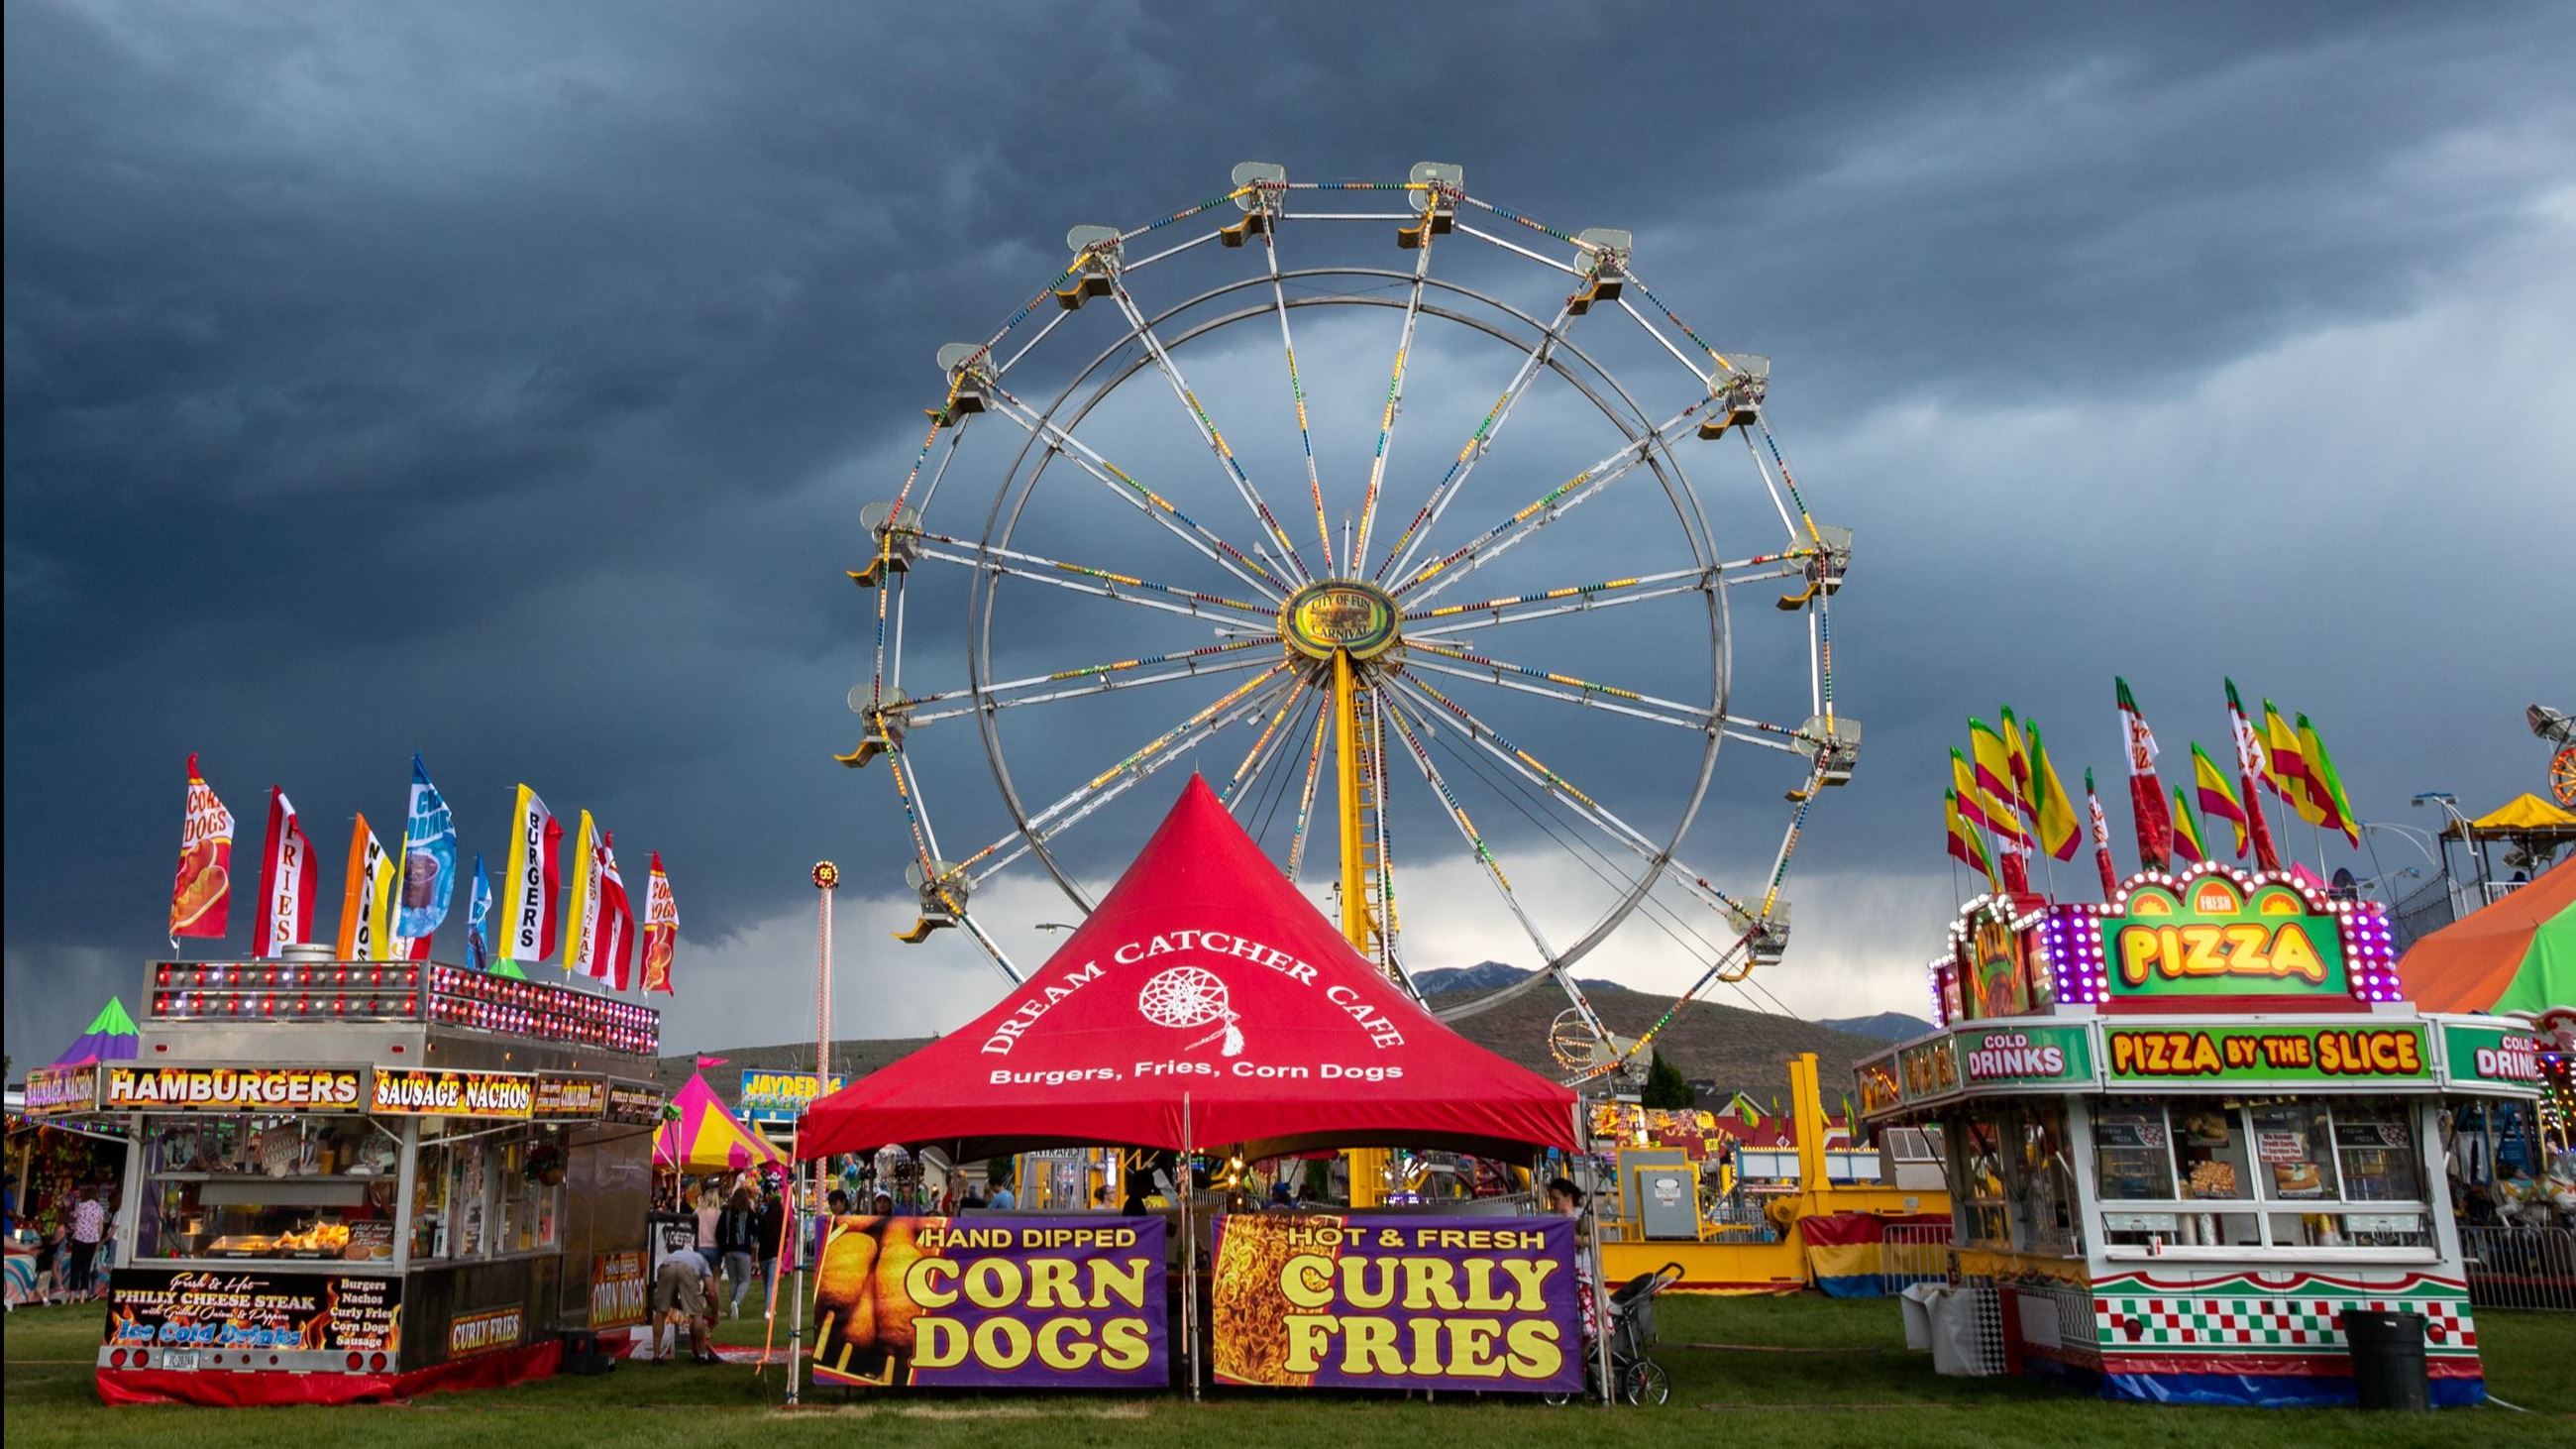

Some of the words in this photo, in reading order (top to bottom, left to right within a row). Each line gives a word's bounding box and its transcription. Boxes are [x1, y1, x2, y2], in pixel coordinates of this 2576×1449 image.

[1311, 595, 1333, 611] CITY
[1336, 595, 1348, 606] OF
[1350, 596, 1371, 612] FUN
[1311, 623, 1367, 639] CARNIVAL
[184, 810, 227, 843] DOGS
[276, 824, 299, 942] FRIES
[521, 811, 540, 947] BURGERS
[2200, 895, 2232, 912] FRESH
[2119, 923, 2328, 985] PIZZA
[981, 960, 1106, 1057] DREAM
[1114, 929, 1319, 987] CATCHER
[1326, 984, 1406, 1051] CAFE
[1984, 1034, 2028, 1049] COLD
[2111, 1032, 2222, 1075] PIZZA
[2225, 1037, 2259, 1067] BY
[2262, 1036, 2311, 1067] THE
[2316, 1031, 2420, 1074] SLICE
[990, 1066, 1124, 1086] Burgers,
[1134, 1059, 1222, 1079] Fries,
[1231, 1061, 1310, 1079] Corn
[1320, 1063, 1404, 1081] Dogs
[1967, 1045, 2066, 1079] DRINKS
[26, 1081, 61, 1107] SAUSAGE
[110, 1070, 357, 1103] HAMBURGERS
[377, 1078, 460, 1107] SAUSAGE
[465, 1081, 530, 1110] NACHOS
[746, 1074, 843, 1099] JAYDEBG
[264, 1136, 294, 1155] GOOD
[921, 1229, 1013, 1248] HAND
[1022, 1229, 1137, 1248] DIPPED
[1288, 1227, 1366, 1247] HOT
[1378, 1229, 1405, 1247] &
[1418, 1230, 1545, 1250] FRESH
[208, 1278, 221, 1289] &
[224, 1276, 269, 1293] Hot
[341, 1278, 386, 1291] Burgers
[905, 1257, 1151, 1309] CORN
[1279, 1255, 1558, 1312] CURLY
[114, 1289, 175, 1305] PHILLY
[180, 1291, 251, 1308] CHEESE
[255, 1295, 315, 1310] STEAK
[342, 1292, 383, 1304] Nachos
[593, 1282, 618, 1324] CORN
[619, 1278, 644, 1319] DOGS
[330, 1306, 363, 1320] Curly
[365, 1307, 392, 1319] Fries
[118, 1319, 155, 1341] Ice
[159, 1321, 216, 1343] Cold
[217, 1323, 303, 1347] Drinks
[331, 1321, 360, 1332] Corn
[363, 1322, 390, 1335] Dogs
[336, 1335, 382, 1348] Sausage
[453, 1319, 489, 1352] CURLY
[489, 1313, 520, 1342] FRIES
[910, 1316, 1151, 1371] DOGS
[1282, 1315, 1562, 1380] FRIES
